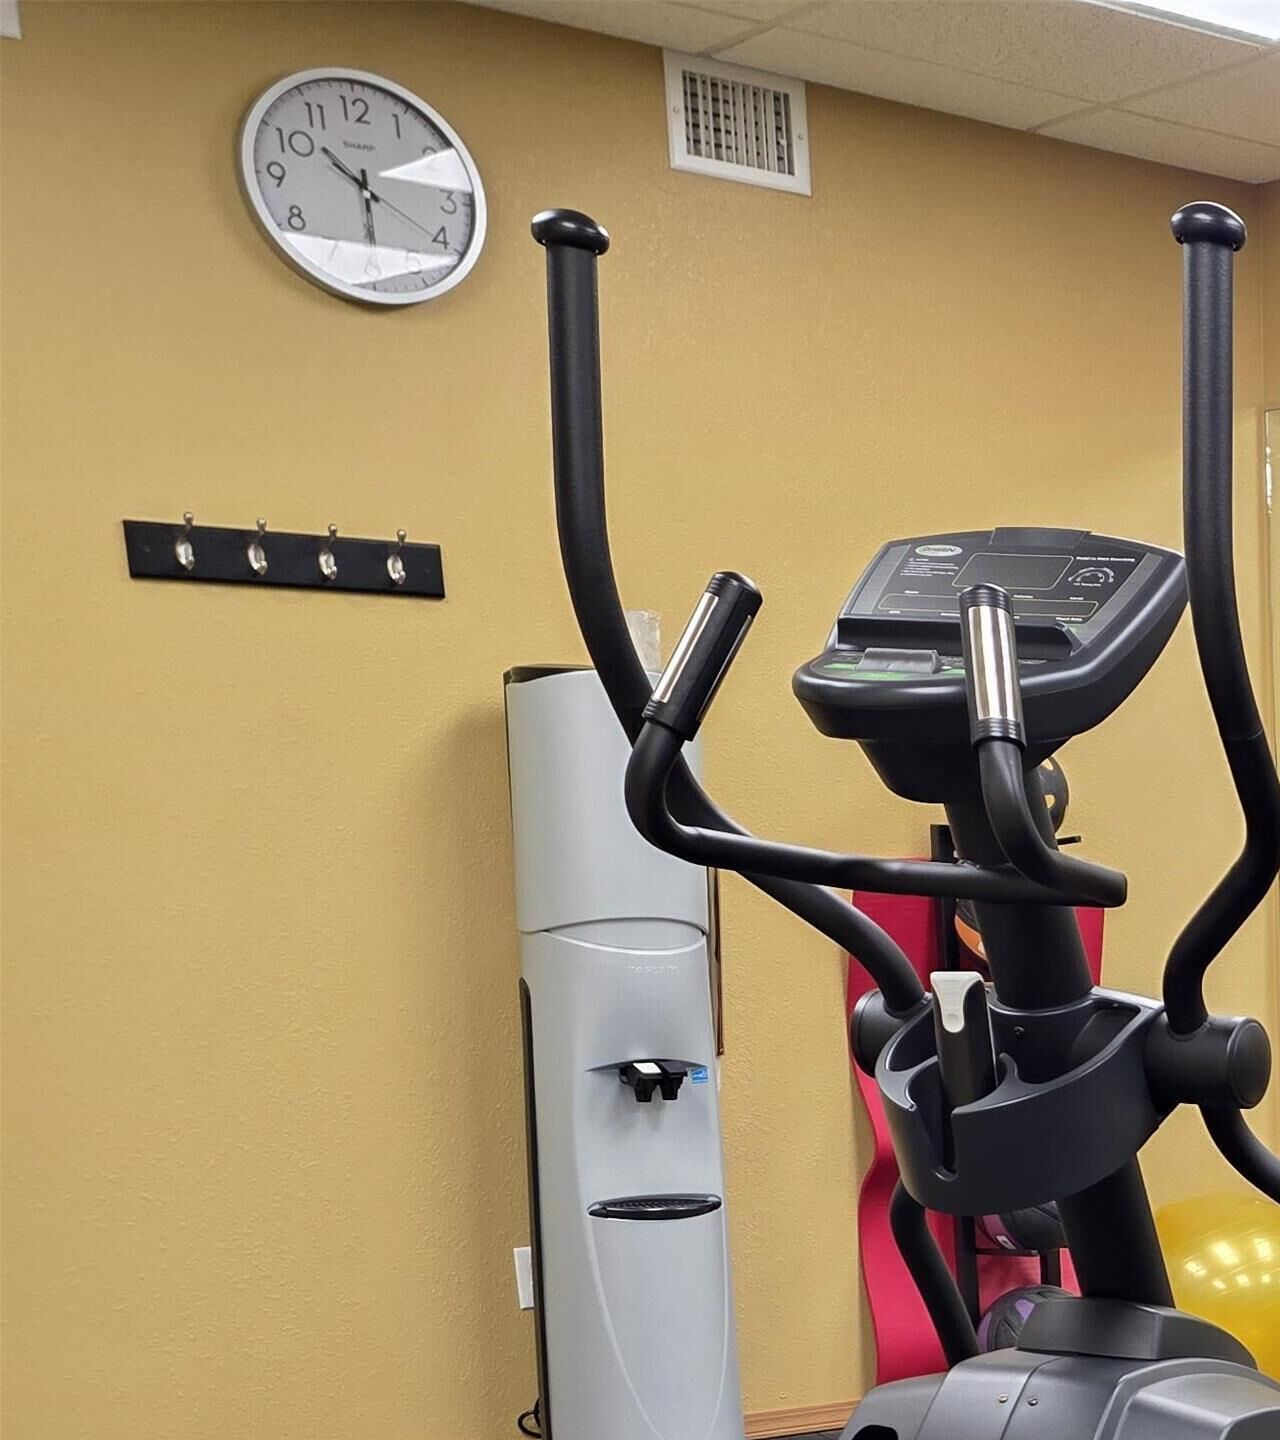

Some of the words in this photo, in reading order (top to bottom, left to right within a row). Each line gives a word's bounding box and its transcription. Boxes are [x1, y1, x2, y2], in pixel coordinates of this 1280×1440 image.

[305, 102, 326, 130] 11
[339, 95, 371, 125] 12
[392, 114, 401, 139] 1
[276, 127, 315, 158] 10
[343, 140, 376, 152] SHARP
[266, 161, 286, 188] 9
[439, 189, 458, 215] 3
[287, 205, 306, 231] 8
[431, 225, 450, 250] 4
